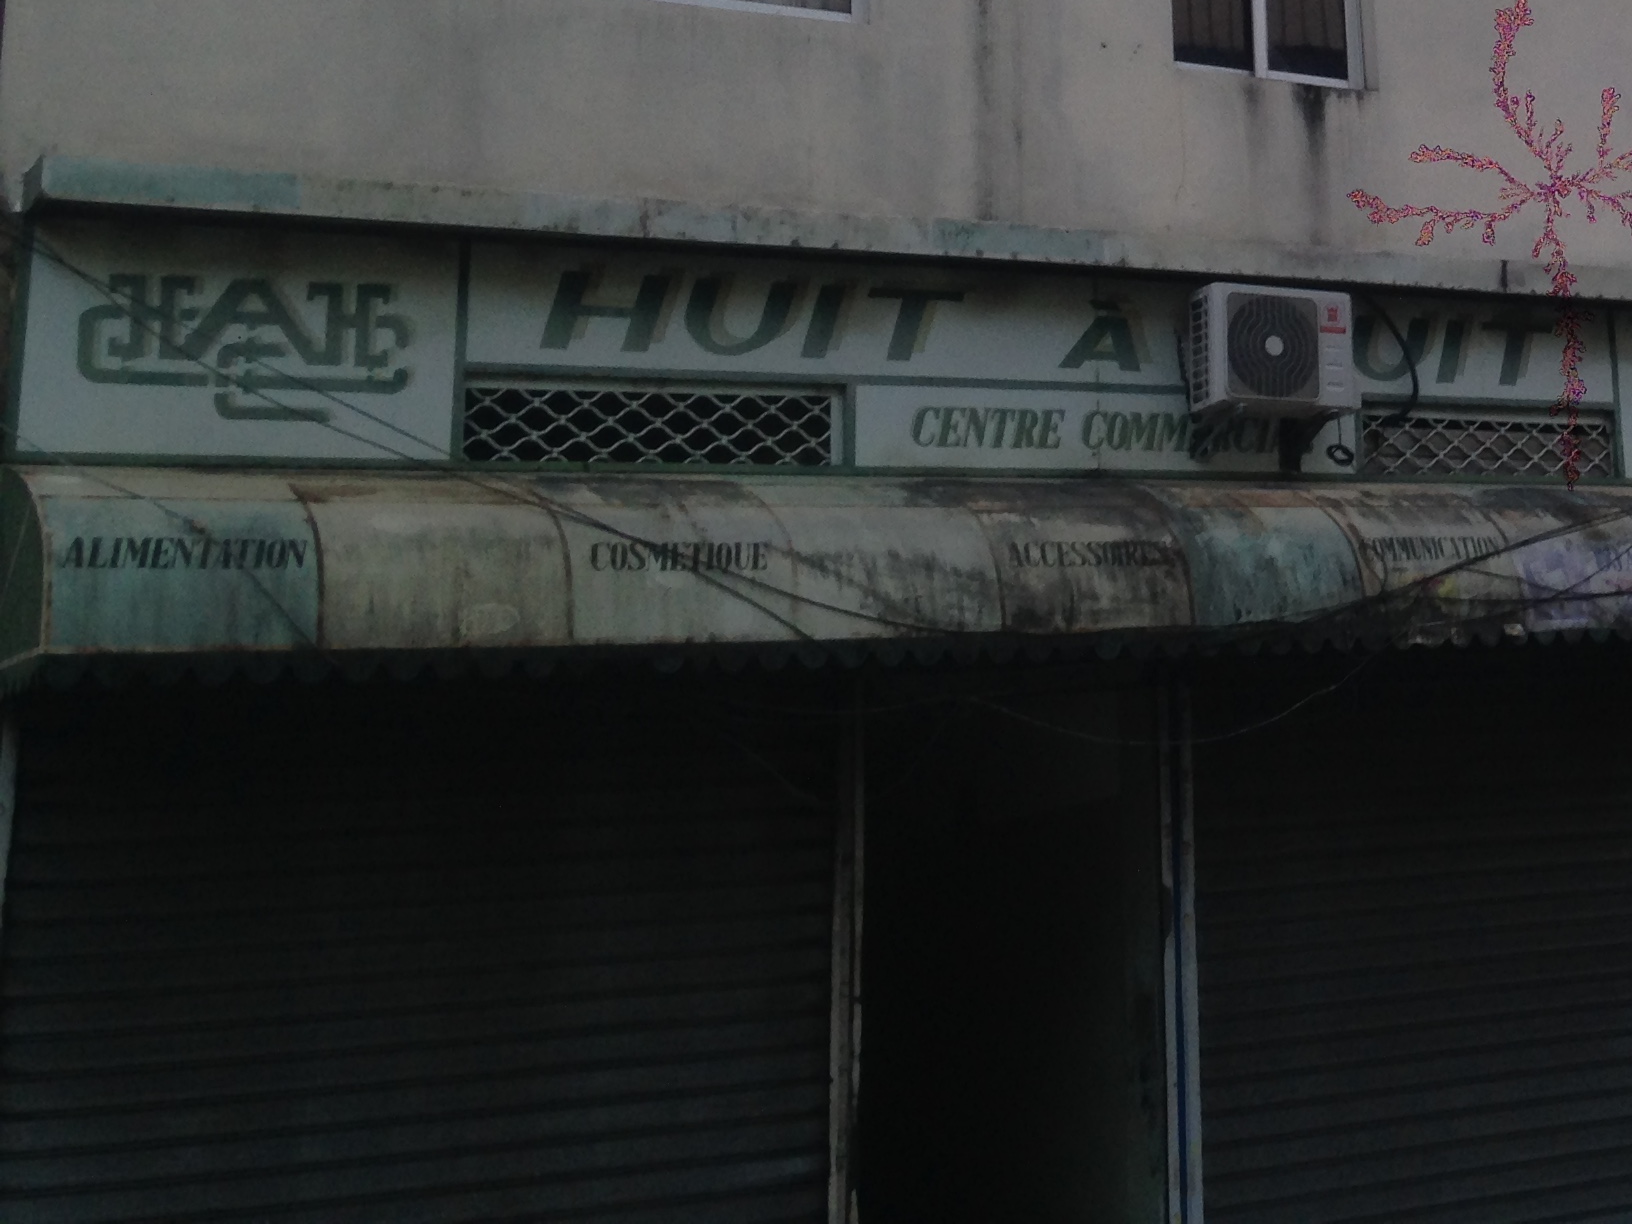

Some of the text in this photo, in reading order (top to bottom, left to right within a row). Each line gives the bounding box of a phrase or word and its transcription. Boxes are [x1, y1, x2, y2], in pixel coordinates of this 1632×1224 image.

[540, 270, 966, 363] HUIT
[1351, 313, 1556, 387] UIT
[910, 405, 1066, 451] CENTRE
[64, 536, 309, 571] ALIMENTATION
[590, 541, 769, 572] COSMETIQUE
